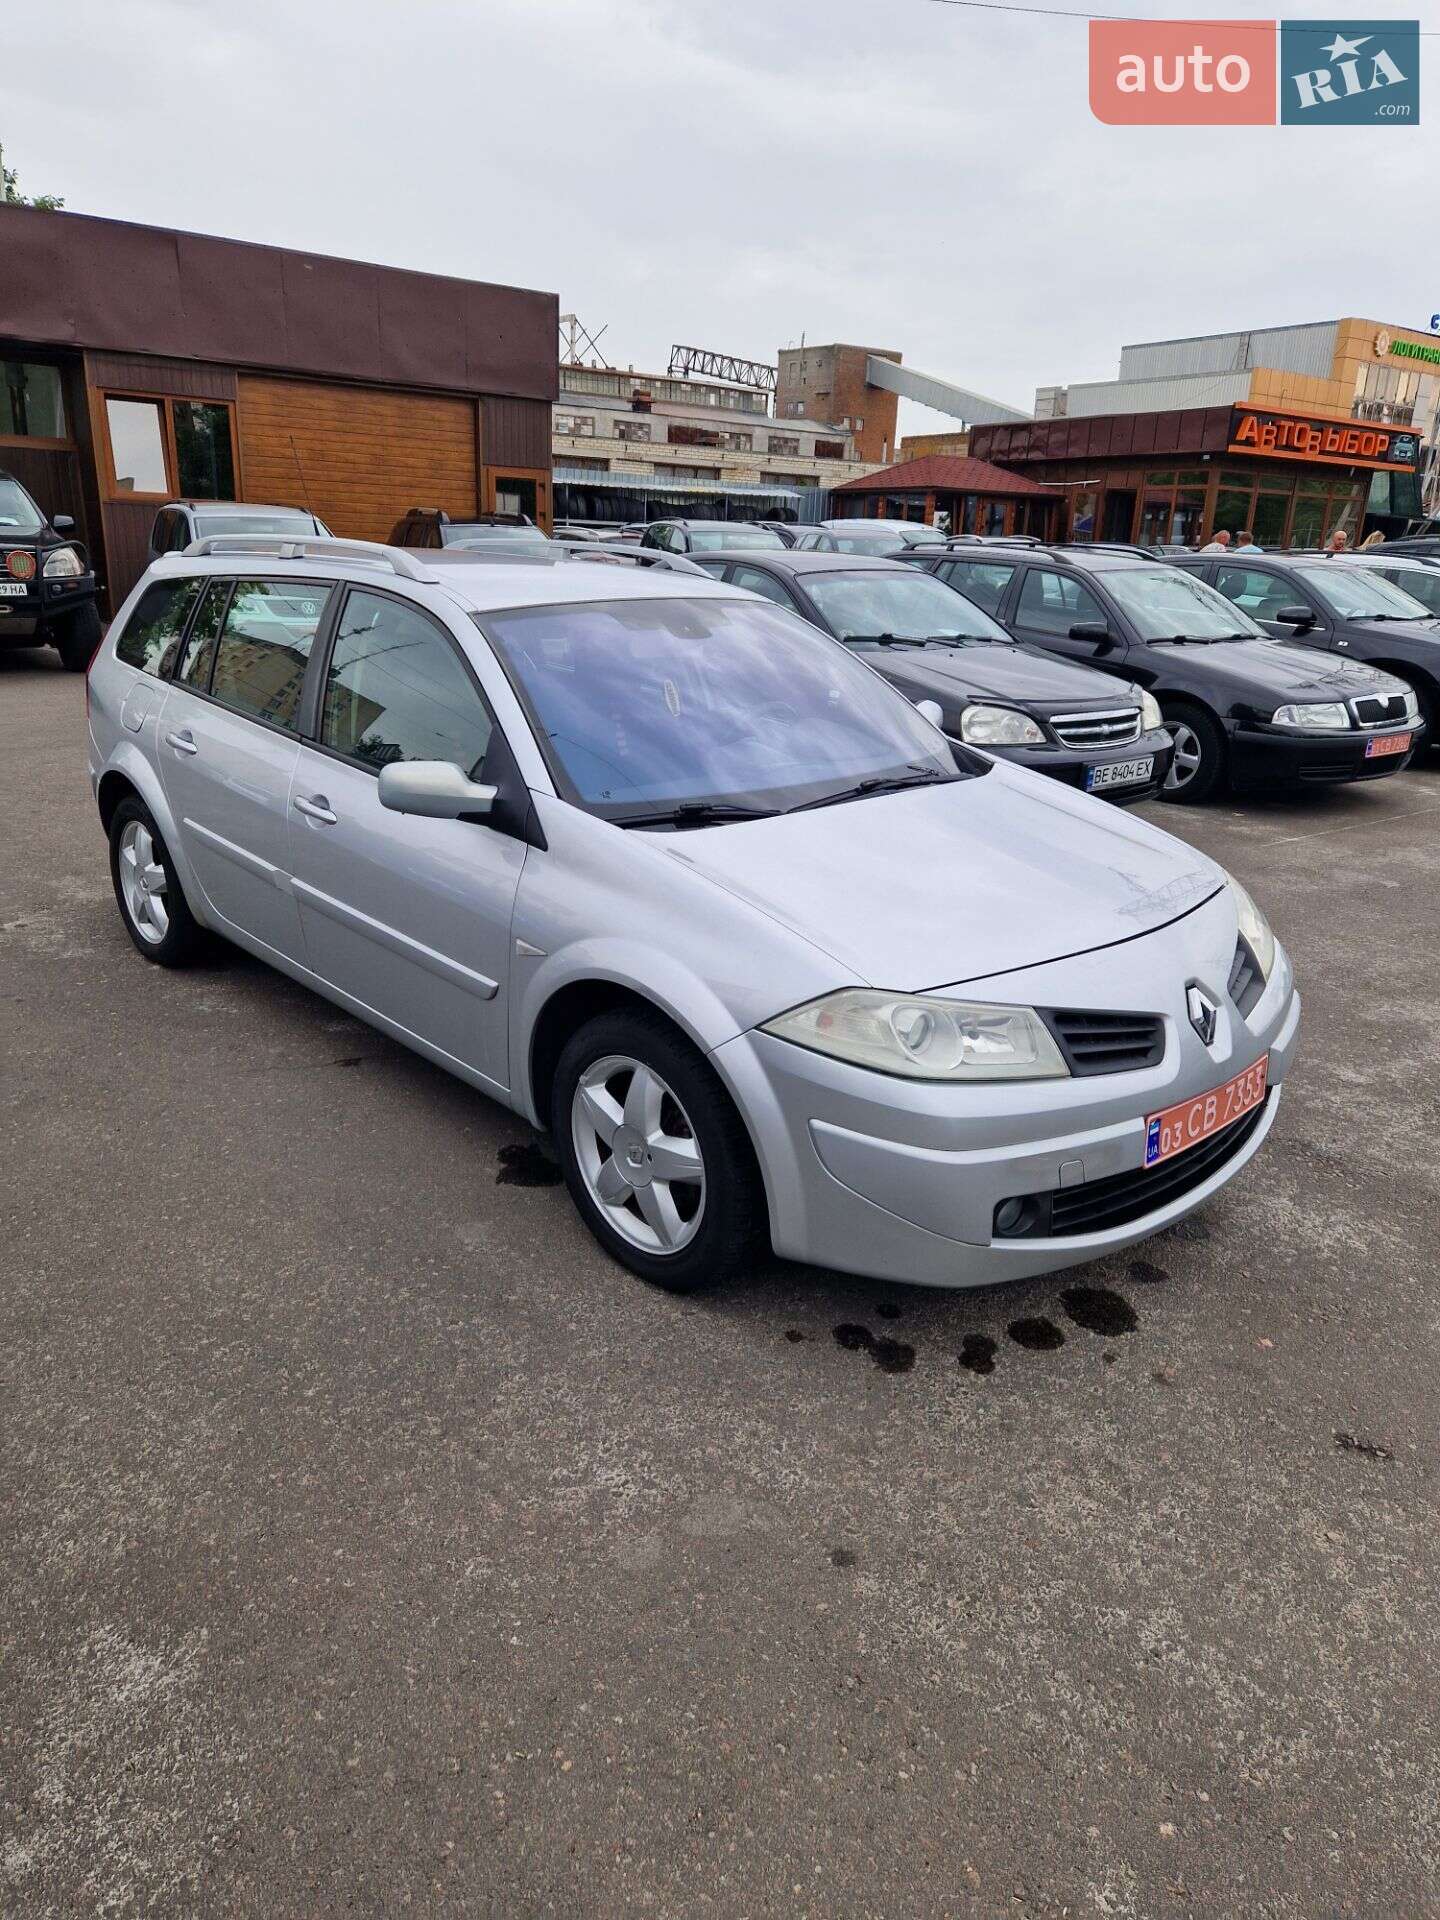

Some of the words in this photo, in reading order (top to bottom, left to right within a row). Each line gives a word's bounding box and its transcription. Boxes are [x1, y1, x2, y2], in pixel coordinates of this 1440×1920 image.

[1095, 768, 1109, 784] BE
[1112, 764, 1134, 780] 8404
[1136, 760, 1152, 776] EX
[1161, 1121, 1183, 1154] 03
[1187, 1095, 1217, 1138] CB
[1223, 1065, 1263, 1120] 7353
